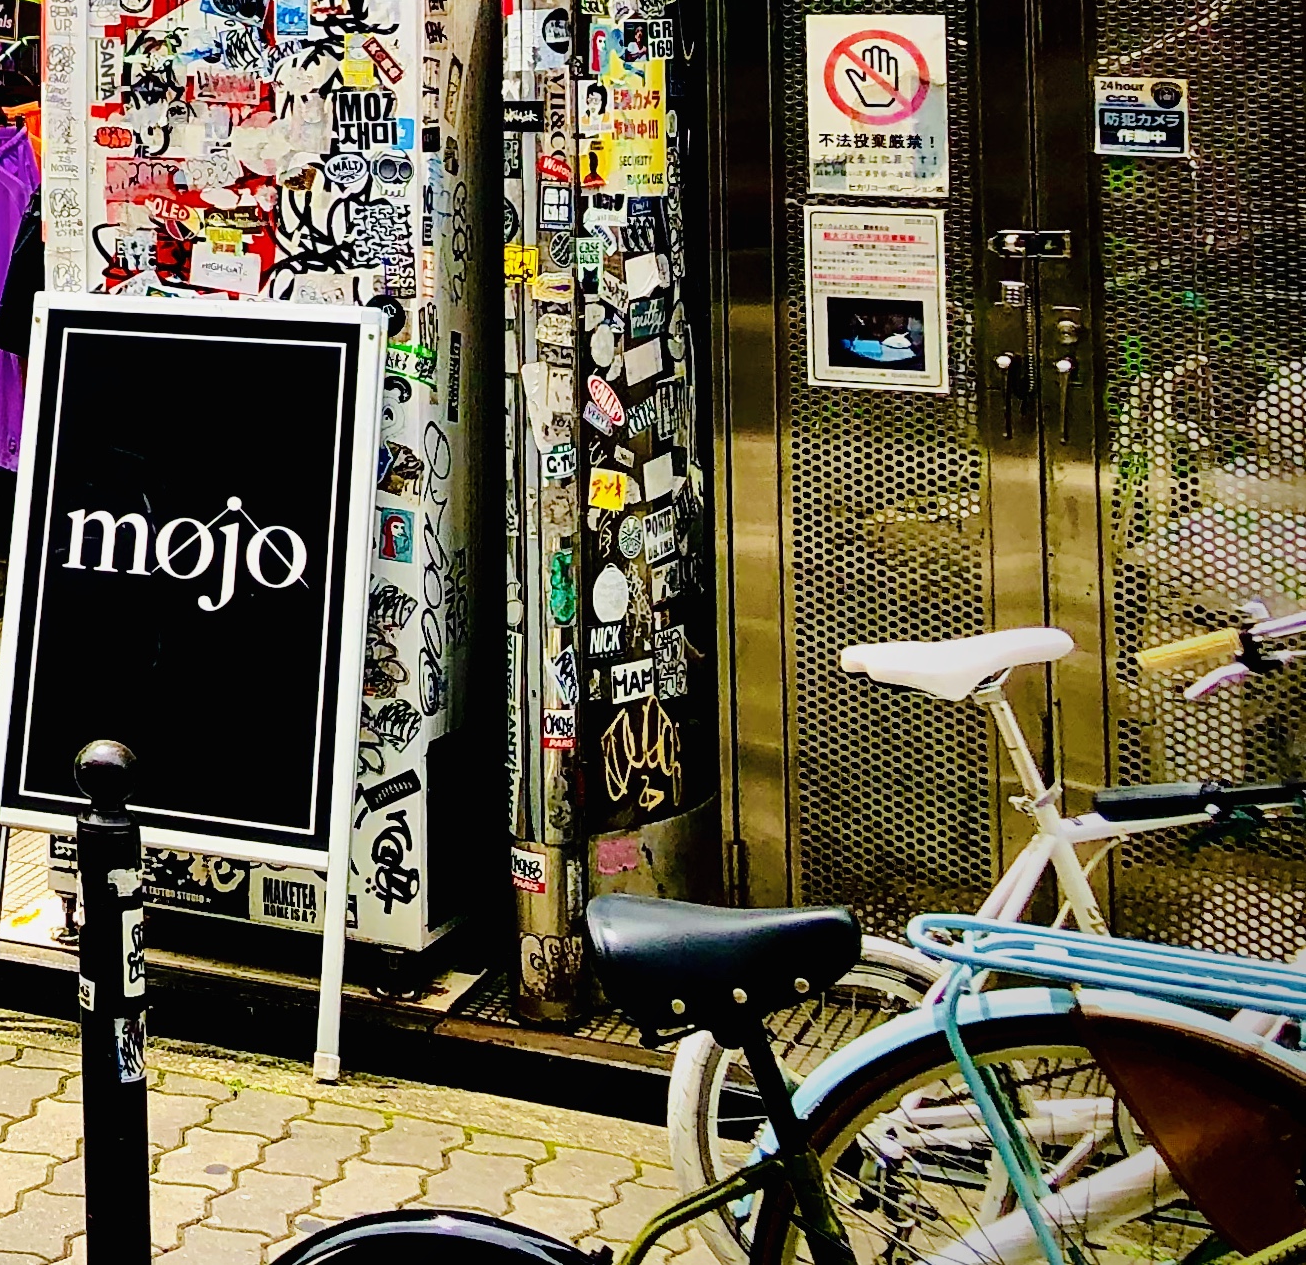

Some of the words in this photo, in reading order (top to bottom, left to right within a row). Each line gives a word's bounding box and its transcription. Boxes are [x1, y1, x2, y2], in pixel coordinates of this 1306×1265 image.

[649, 21, 673, 39] GR
[649, 39, 673, 58] 169
[100, 38, 116, 101] SANTA
[1103, 112, 1180, 128] 防犯カメラ
[818, 133, 935, 150] 不法投棄厳禁！
[589, 624, 622, 654] NICK
